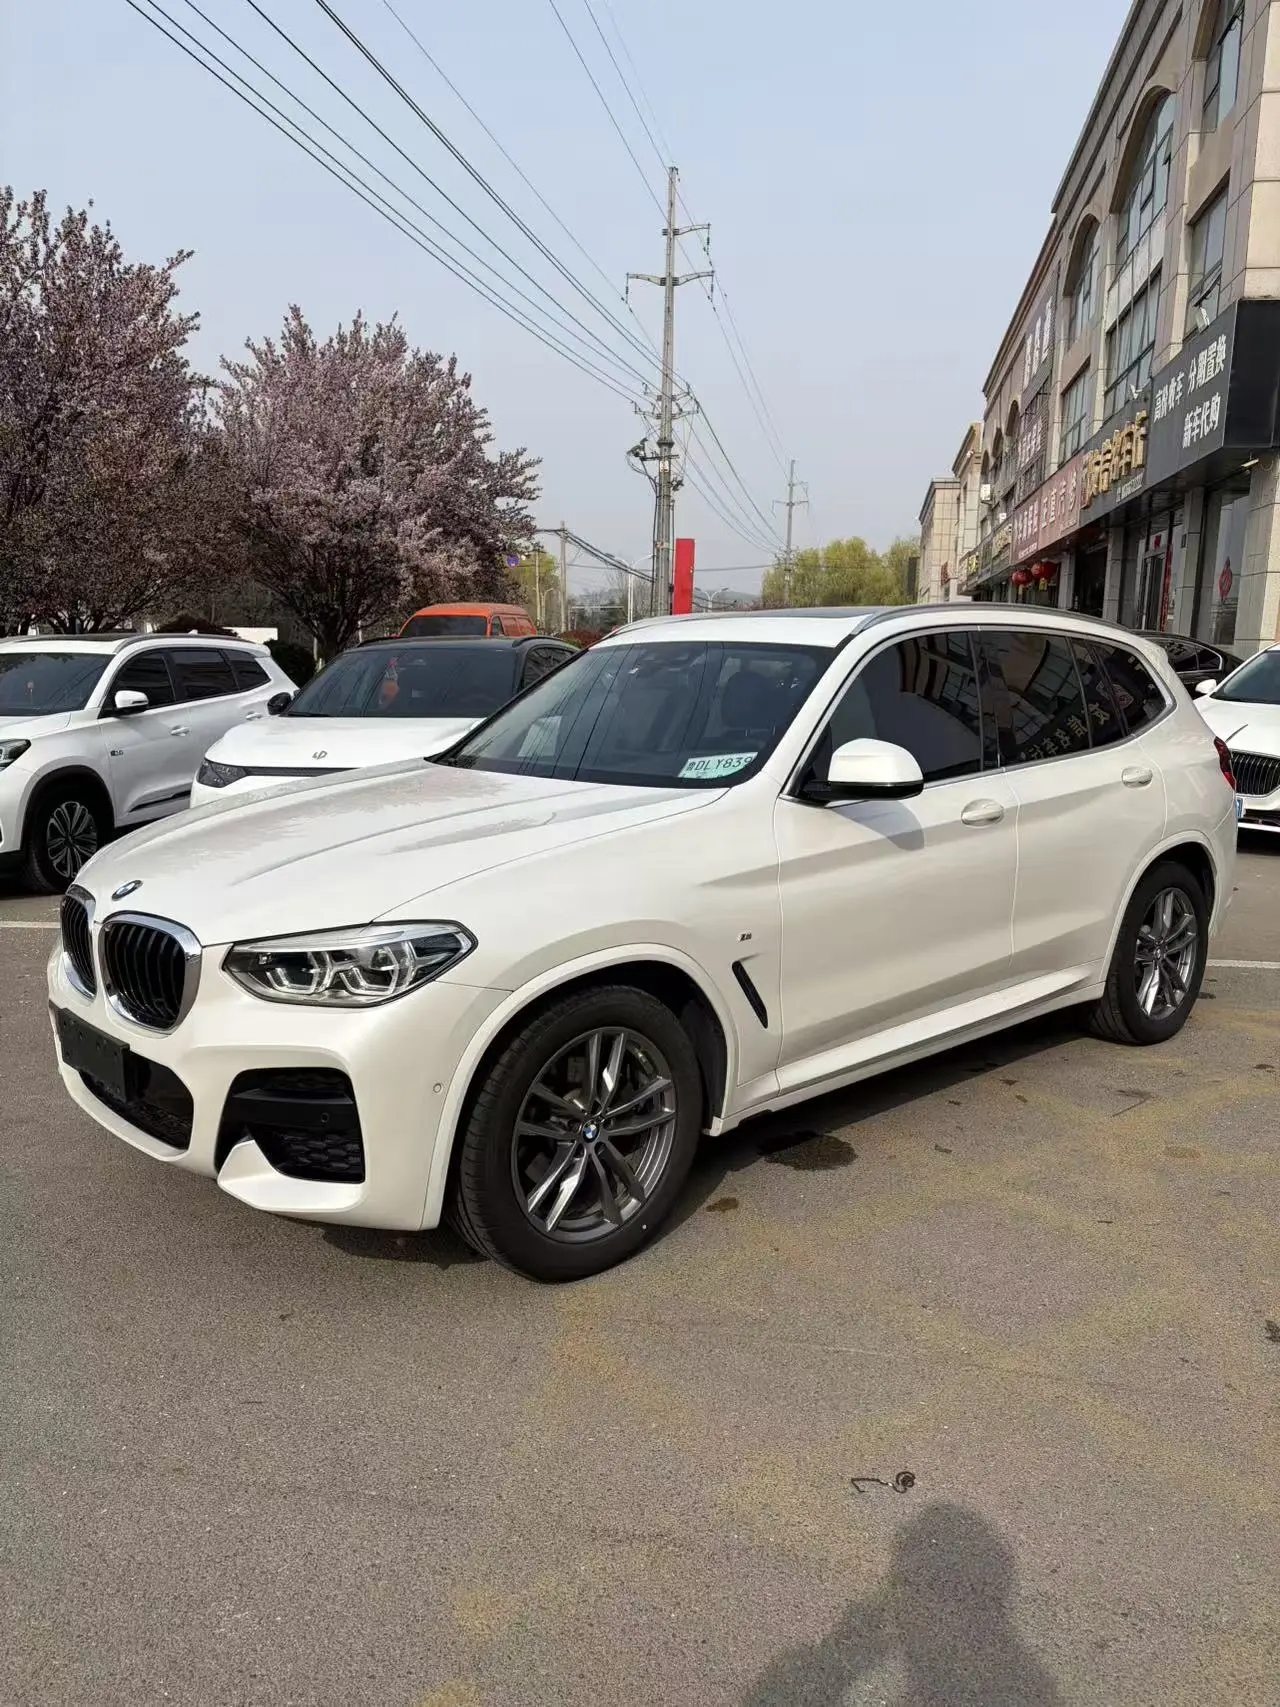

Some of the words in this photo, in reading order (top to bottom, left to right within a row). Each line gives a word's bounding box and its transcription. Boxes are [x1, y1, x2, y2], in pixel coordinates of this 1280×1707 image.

[1187, 334, 1227, 395] 分期置换
[1182, 392, 1221, 449] 新车代购
